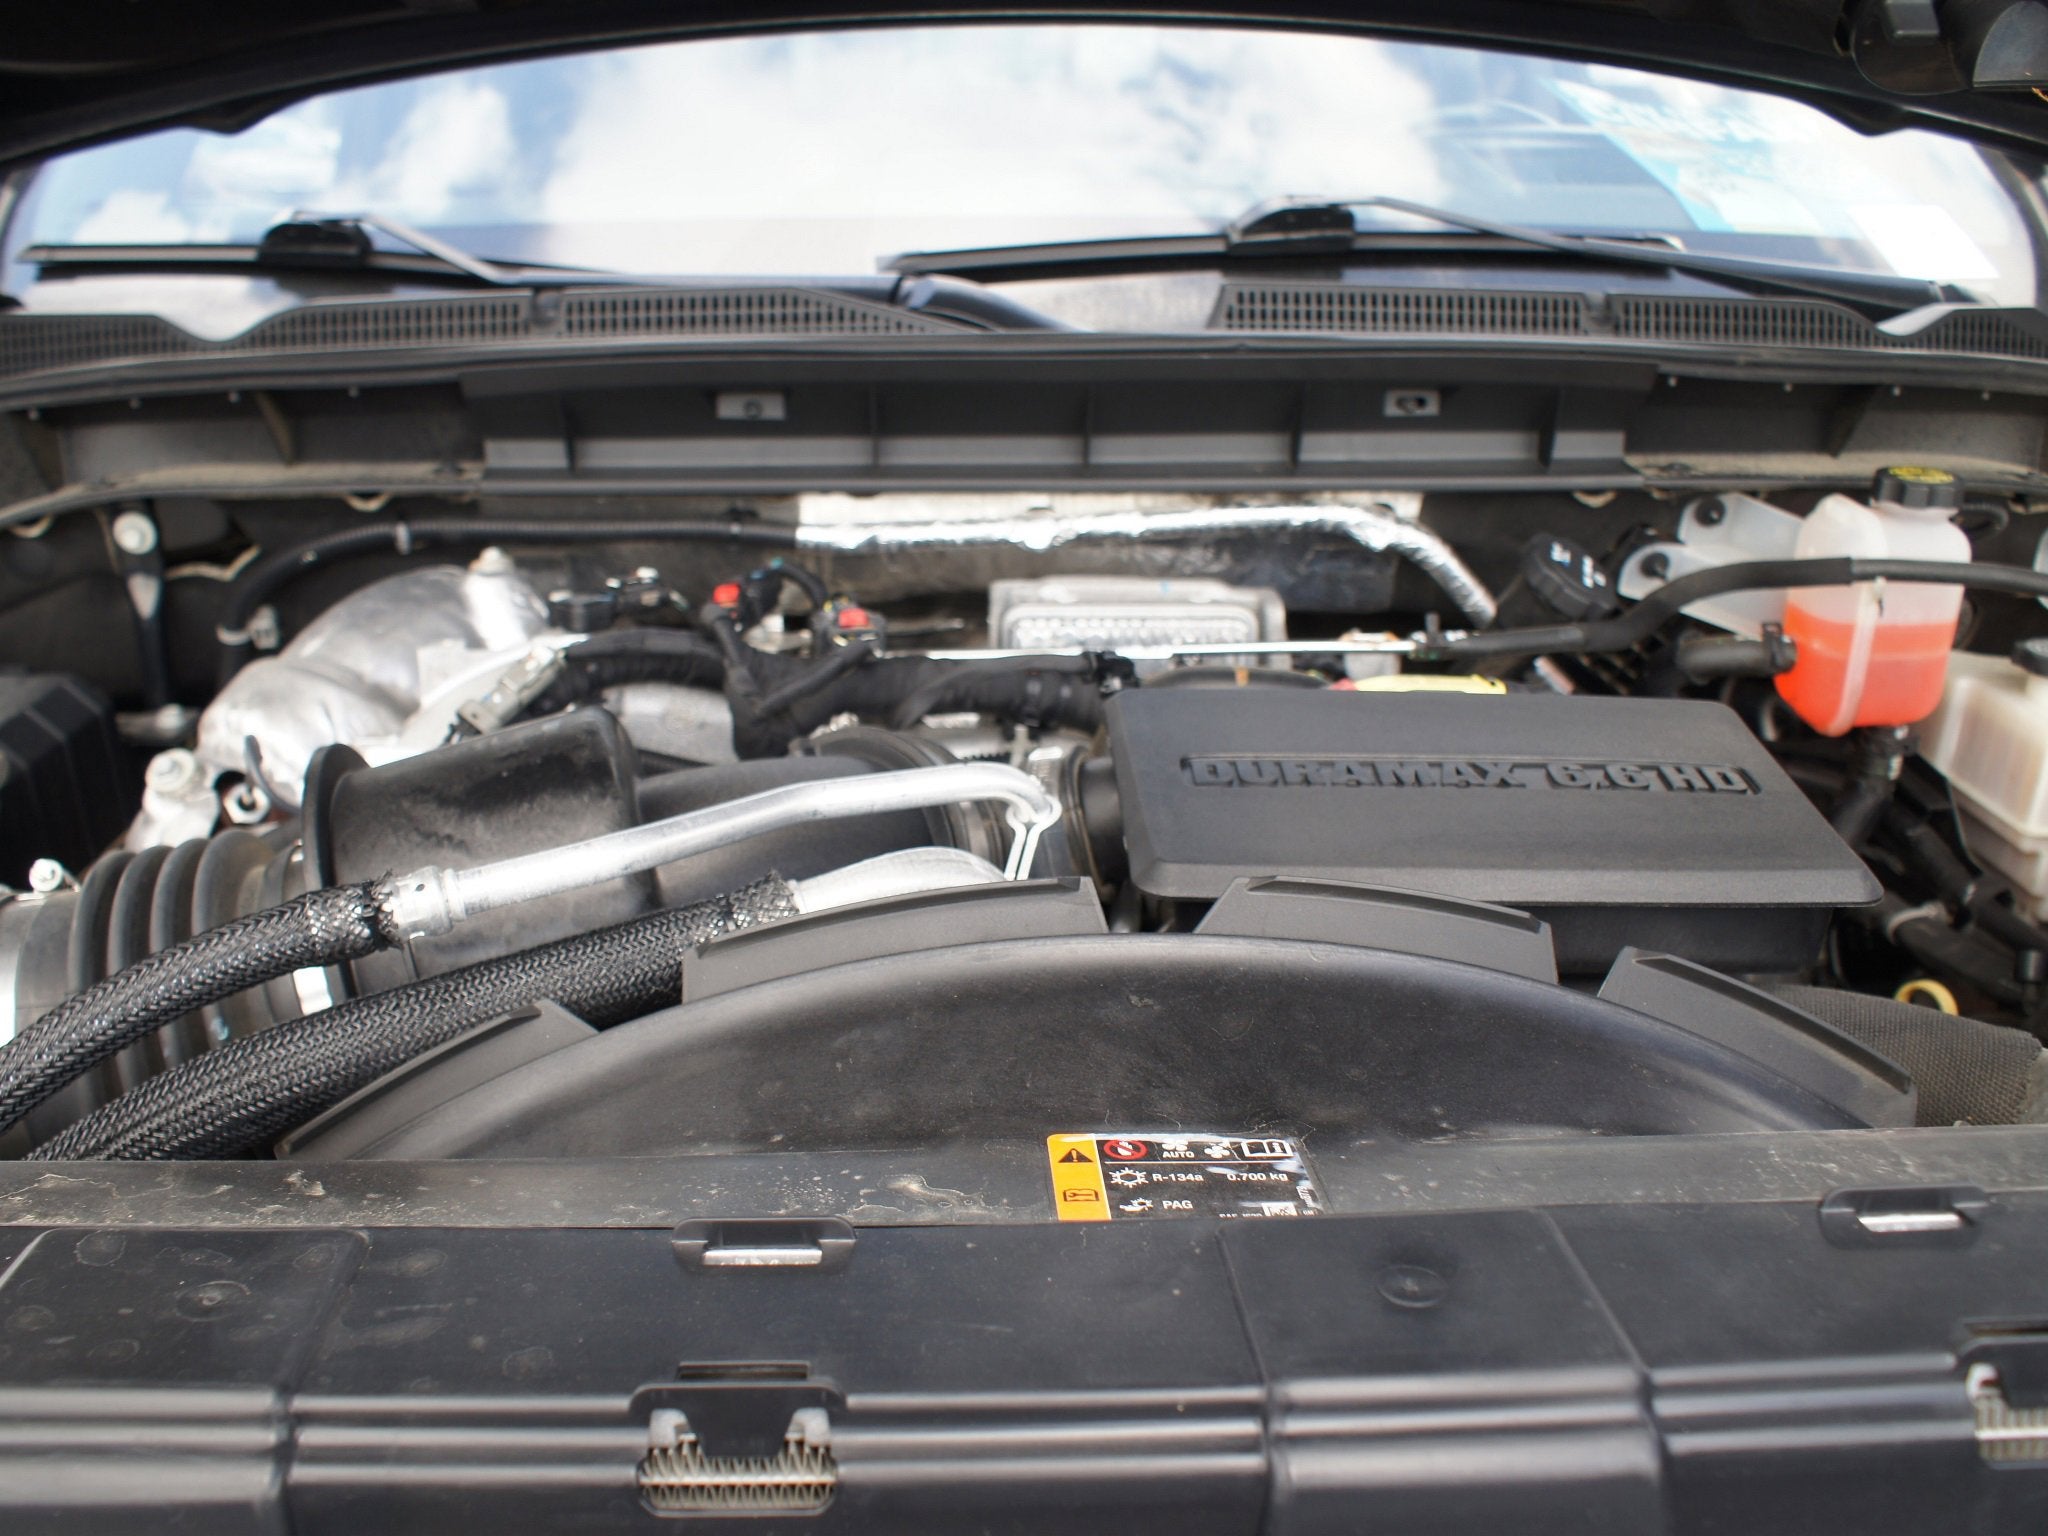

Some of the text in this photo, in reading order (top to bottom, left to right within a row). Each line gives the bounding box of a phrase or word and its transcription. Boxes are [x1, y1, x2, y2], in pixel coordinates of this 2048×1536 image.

[1191, 760, 1749, 794] DURAMAX 6.6 HD
[1162, 1150, 1196, 1159] AUTO
[1153, 1173, 1204, 1182] R-134a
[1226, 1172, 1289, 1182] 0.700 kg
[1162, 1199, 1194, 1210] PAG
